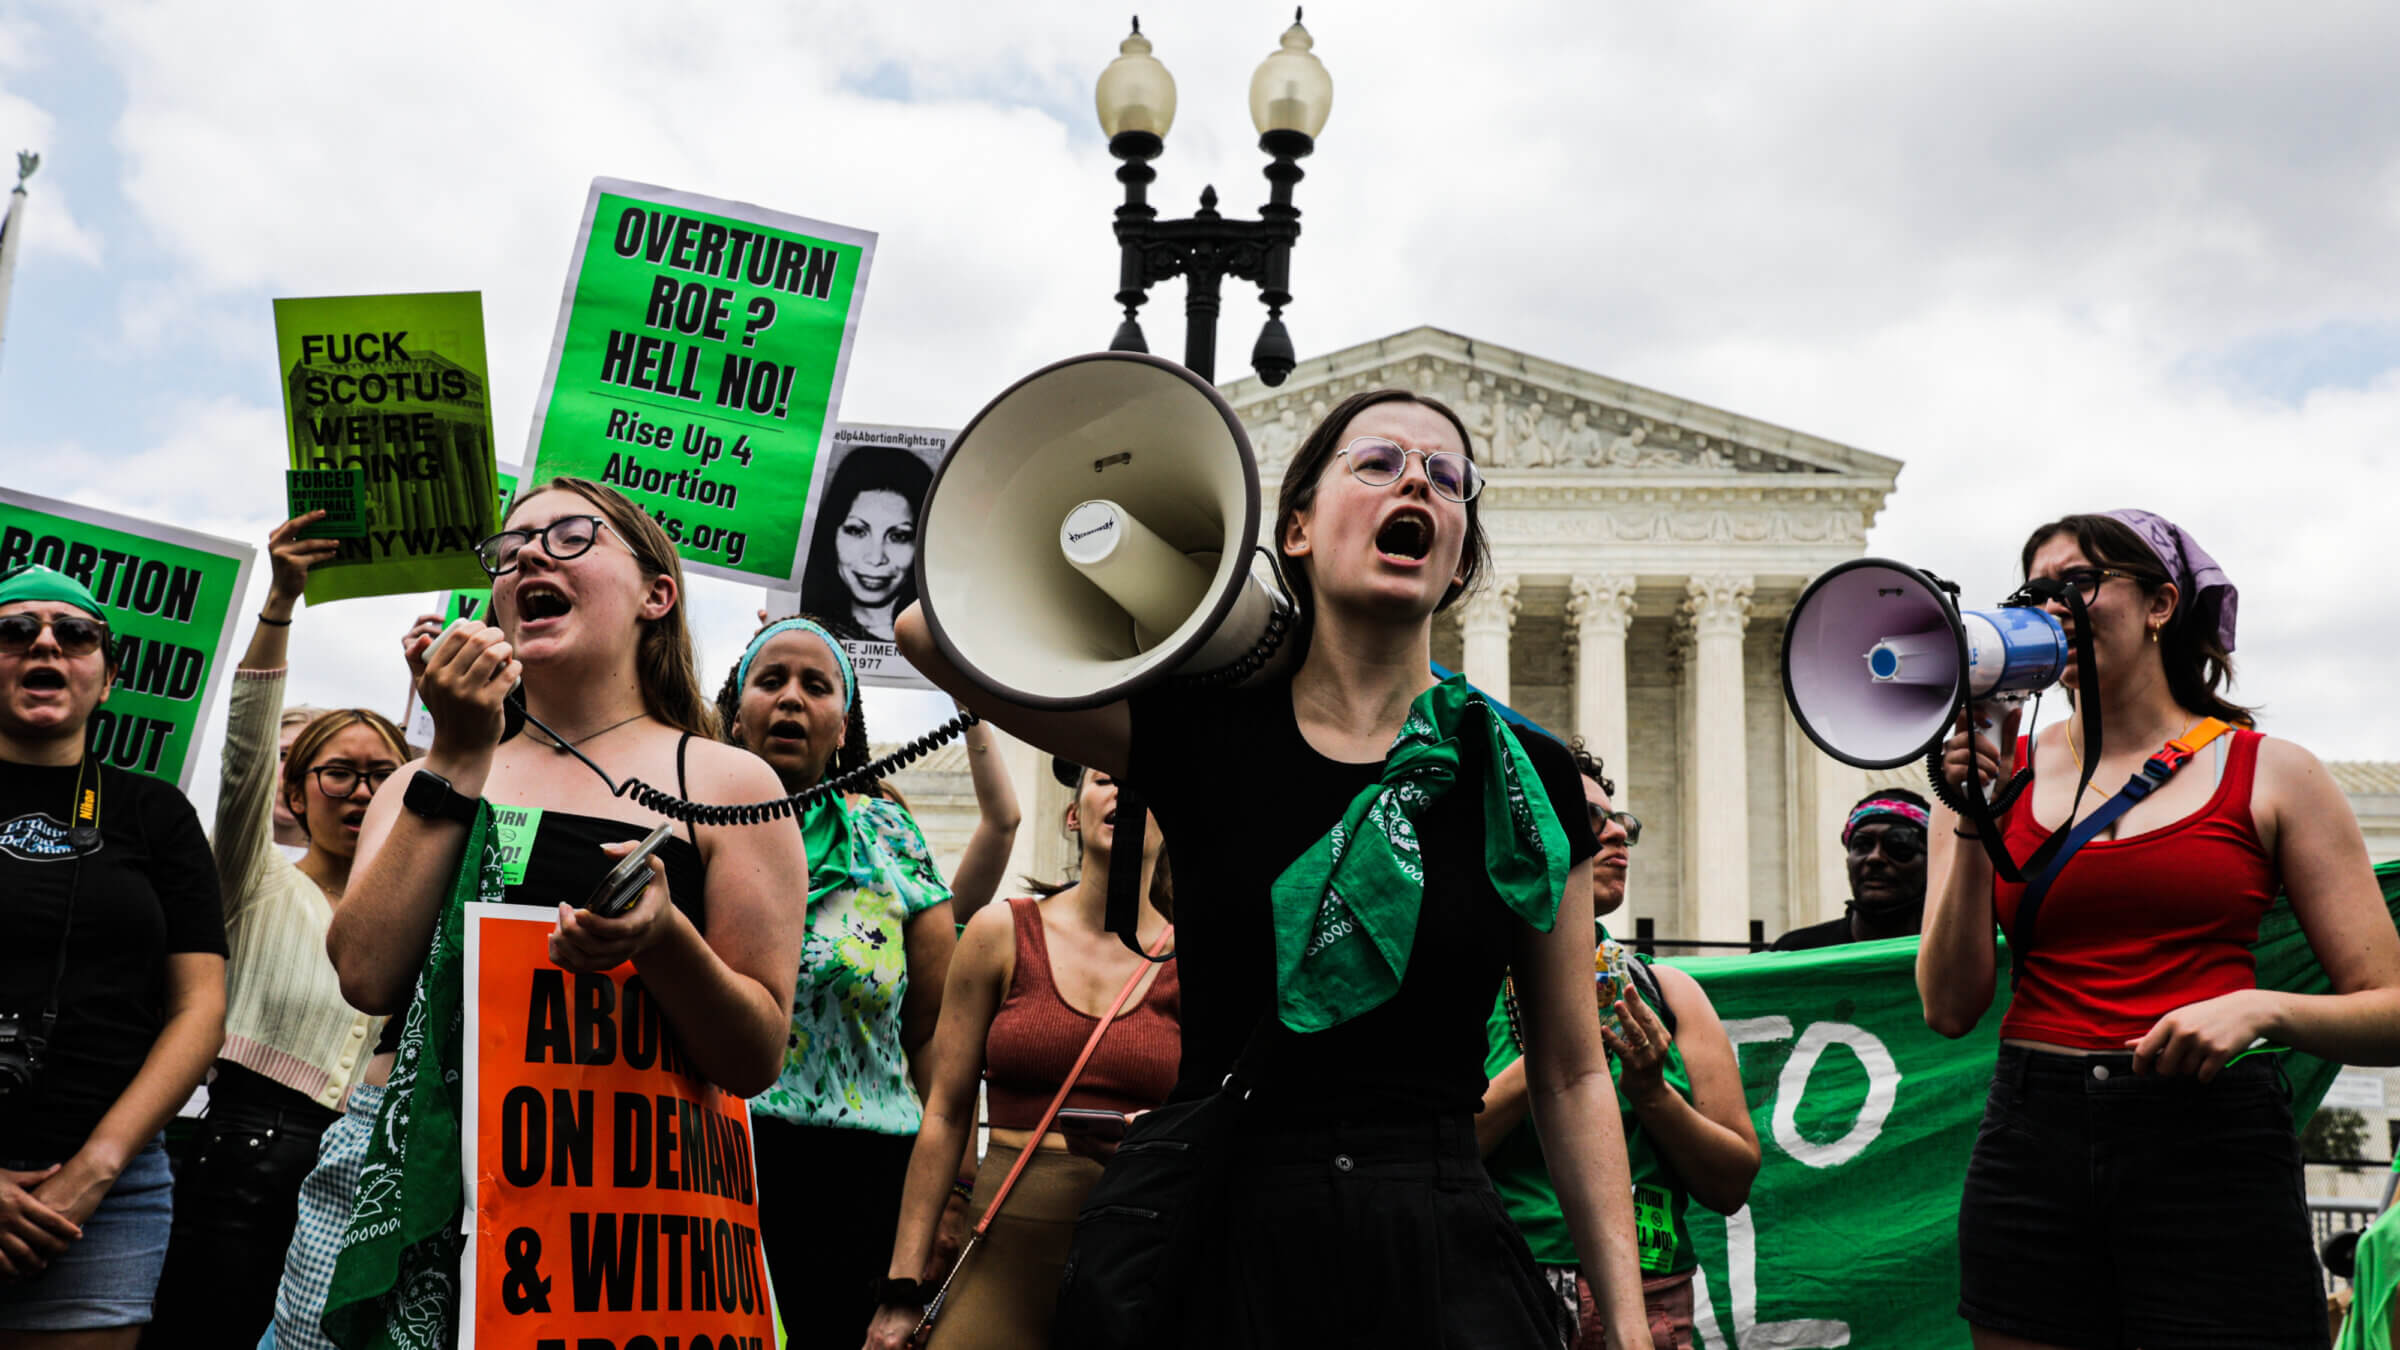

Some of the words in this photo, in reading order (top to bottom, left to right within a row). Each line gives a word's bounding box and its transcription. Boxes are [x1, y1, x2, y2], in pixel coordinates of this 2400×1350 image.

[613, 207, 838, 299] OVERTURN
[646, 275, 735, 341] ROE
[743, 296, 776, 346] ?
[302, 331, 411, 365] FUCK
[600, 330, 702, 401] HELL
[716, 353, 796, 417] NO!
[305, 369, 467, 406] SCOTUS
[310, 413, 436, 446] WE'RE
[606, 408, 673, 450] Rise
[683, 424, 722, 465] Up
[731, 435, 752, 466] 4
[293, 472, 354, 488] FORCED
[294, 500, 305, 512] IS
[601, 453, 737, 509] Abortion
[336, 526, 483, 562] NYWAY
[640, 504, 747, 565] ts.org
[111, 634, 205, 702] AND
[80, 788, 95, 820] Nikon
[502, 1086, 594, 1188] ON
[613, 1091, 754, 1206] DEMAND
[502, 1226, 551, 1316] &
[570, 1212, 765, 1316] WITHOUT
